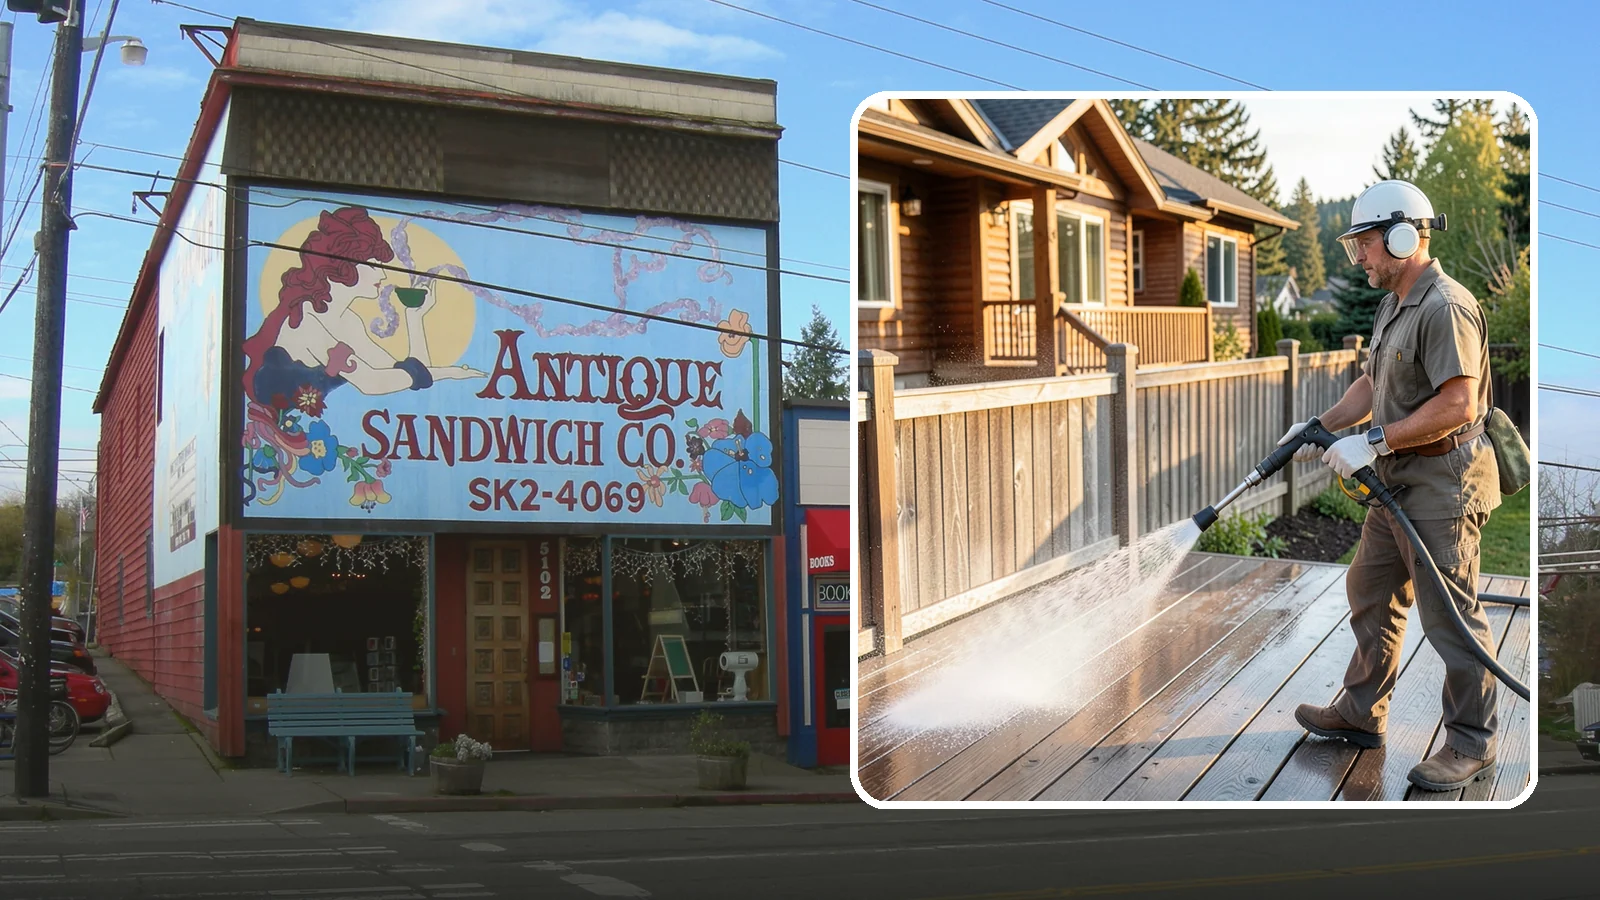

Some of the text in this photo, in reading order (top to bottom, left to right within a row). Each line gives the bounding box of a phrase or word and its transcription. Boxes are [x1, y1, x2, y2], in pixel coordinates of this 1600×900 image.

[476, 329, 724, 421] ANTIQUE
[361, 408, 685, 469] SANDWICH CO.
[468, 477, 646, 513] SK2-4069
[540, 541, 552, 600] 5102
[809, 555, 835, 569] BOOKS
